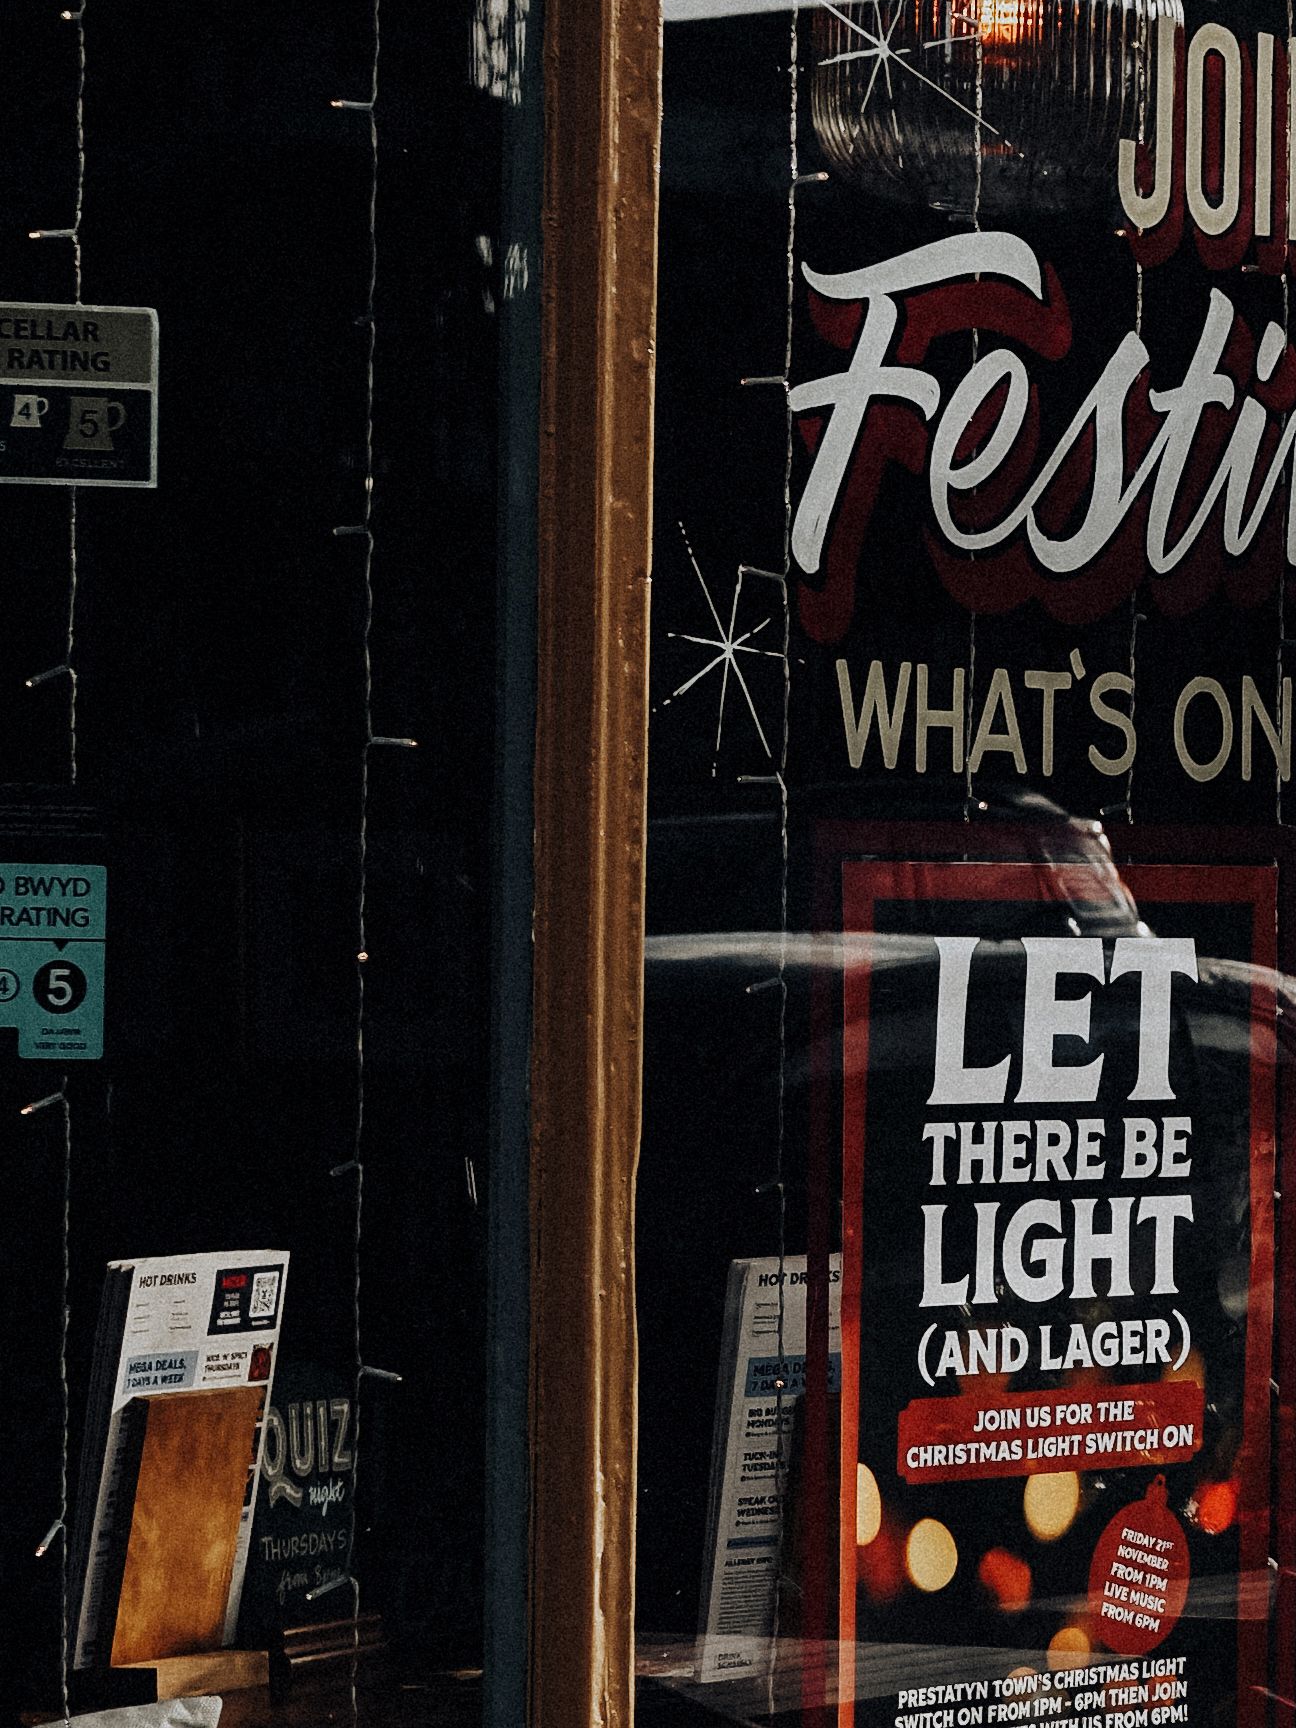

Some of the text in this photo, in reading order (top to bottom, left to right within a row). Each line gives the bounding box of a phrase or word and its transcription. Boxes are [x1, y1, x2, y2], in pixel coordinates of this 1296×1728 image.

[0, 318, 99, 342] CELLAR
[8, 348, 110, 372] RATING
[18, 402, 98, 438] 4 5
[836, 649, 1294, 783] WHAT'S ON
[15, 876, 91, 897] BWYD
[0, 907, 89, 927] RATING
[48, 968, 73, 1006] 5
[926, 936, 1198, 1105] LET
[921, 1117, 1192, 1185] THERE BE
[919, 1194, 1194, 1307] LIGHT
[139, 1272, 197, 1289] HOT DRINKS
[918, 1309, 1191, 1387] (AND LAGER)
[129, 1361, 152, 1374] MEGA
[973, 1400, 1135, 1432] JOIN US FOR THE
[260, 1398, 351, 1508] QUIZ
[906, 1424, 1194, 1468] CHRISTMAS LIGHT SWITCH ON
[308, 1477, 346, 1517] night
[260, 1528, 347, 1561] THURSDAYS
[1121, 1528, 1156, 1548] FRIDAY
[1117, 1544, 1169, 1571] NOVEMBER
[1110, 1561, 1168, 1592] FROM 1PM
[1103, 1580, 1166, 1613] LIVE MUSIC
[1101, 1601, 1160, 1633] FROM 6PM
[898, 1656, 1186, 1709] PRESTATYN TOWN'S CHRISTMAS LIGHT
[958, 1706, 983, 1728] ON
[988, 1699, 1030, 1724] FROM
[1033, 1696, 1062, 1718] 1PM
[1074, 1690, 1106, 1712] 6PM
[1108, 1685, 1149, 1707] THEN
[1151, 1680, 1188, 1702] JOIN
[1151, 1704, 1188, 1726] 6PM!
